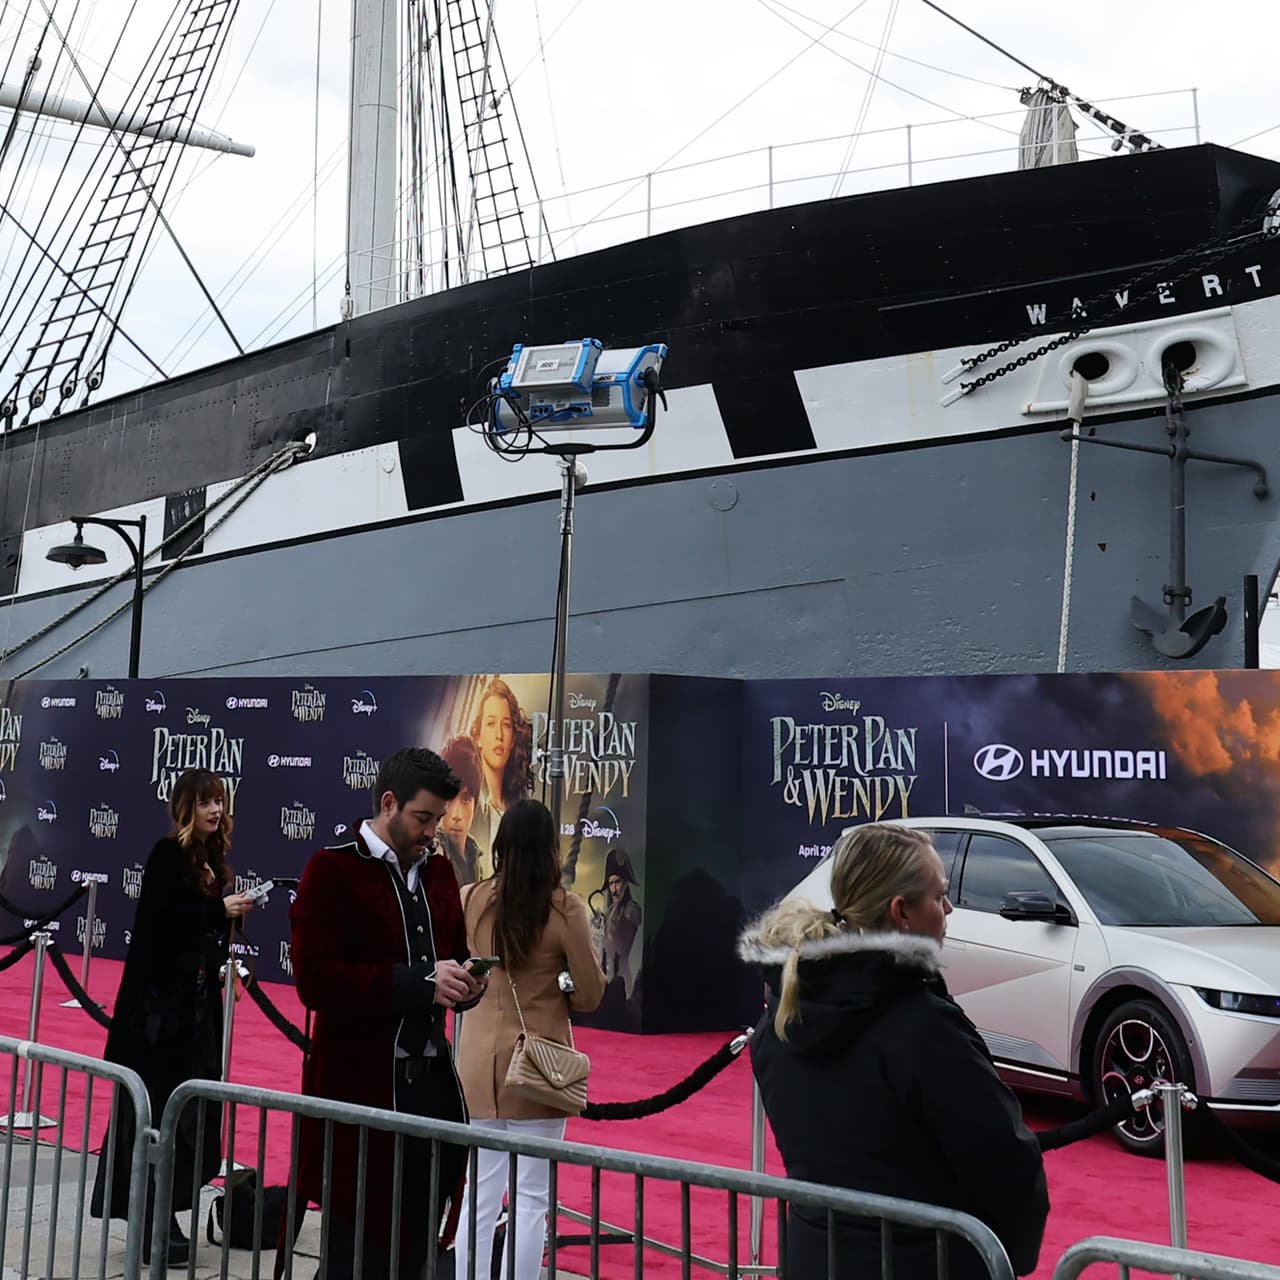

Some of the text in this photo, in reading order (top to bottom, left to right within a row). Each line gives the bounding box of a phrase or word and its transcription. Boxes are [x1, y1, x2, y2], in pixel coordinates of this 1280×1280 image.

[50, 697, 76, 707] HYUNDAI
[238, 698, 268, 708] HYUNDAI
[568, 692, 598, 712] Disney
[820, 691, 861, 716] Disney
[0, 707, 23, 742] PAN
[185, 707, 211, 728] Disney
[529, 712, 638, 770] PETER PAN
[770, 716, 918, 786] PETER PAN
[150, 727, 245, 784] PETER PAN
[280, 756, 312, 767] HYUNDAI
[1031, 749, 1167, 780] HYUNDAI
[801, 768, 919, 827] WENDY
[580, 818, 622, 844] Disney+
[798, 844, 820, 858] April
